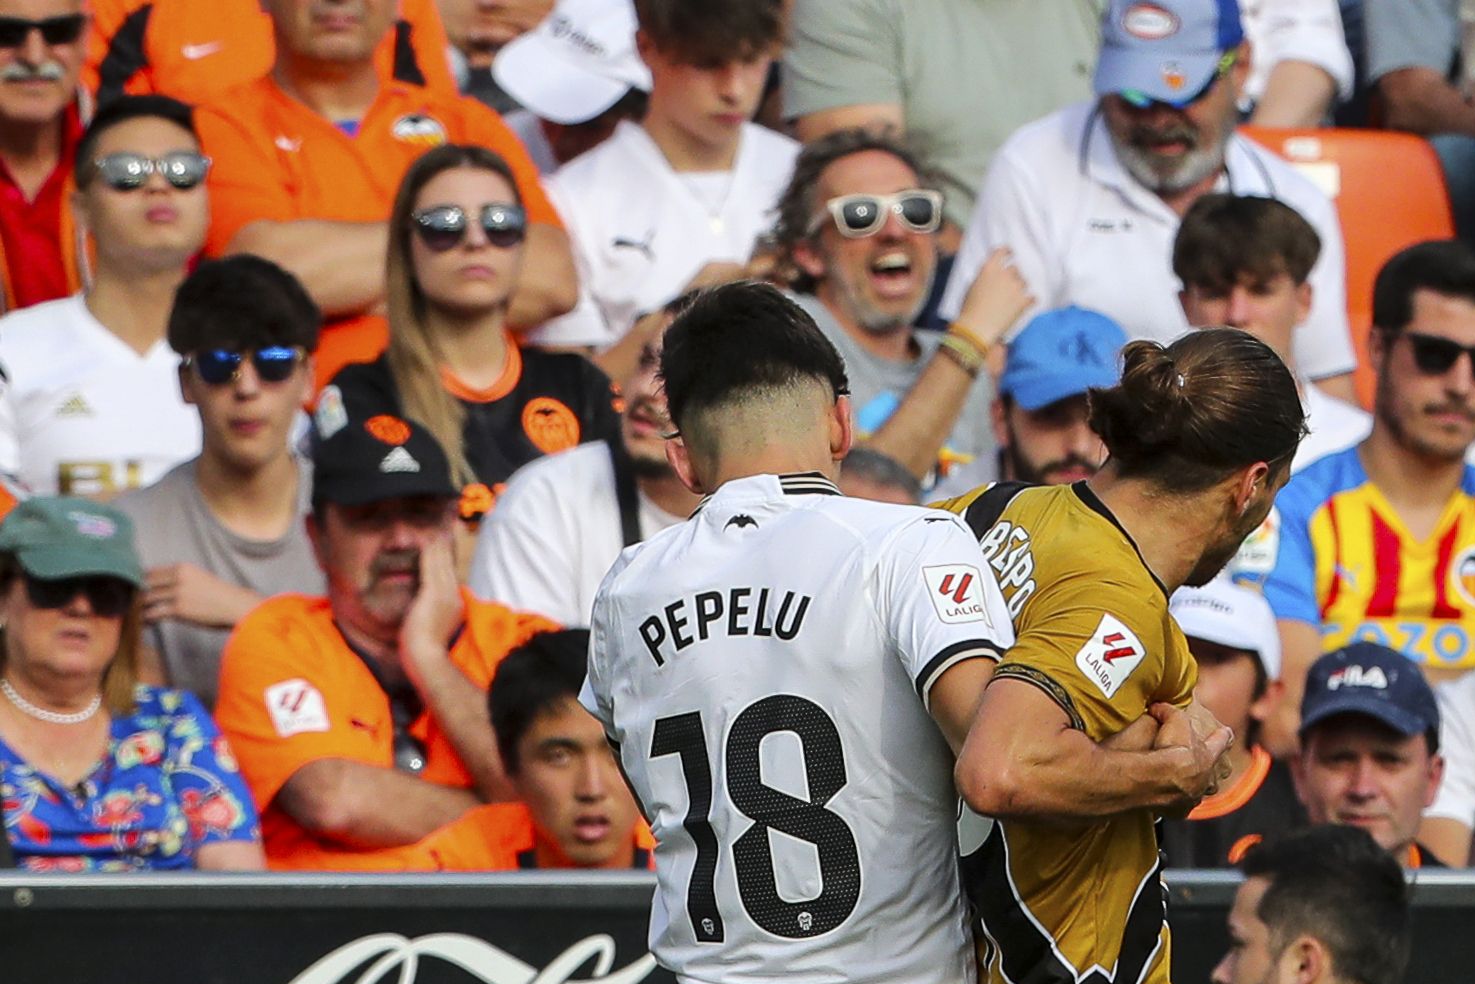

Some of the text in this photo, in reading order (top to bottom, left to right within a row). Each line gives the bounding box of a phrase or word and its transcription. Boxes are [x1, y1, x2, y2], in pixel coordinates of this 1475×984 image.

[638, 586, 812, 668] PEPELU
[945, 603, 985, 617] LALIG
[1084, 652, 1113, 693] LALIGA
[1327, 664, 1389, 691] FILA
[649, 693, 861, 941] 18
